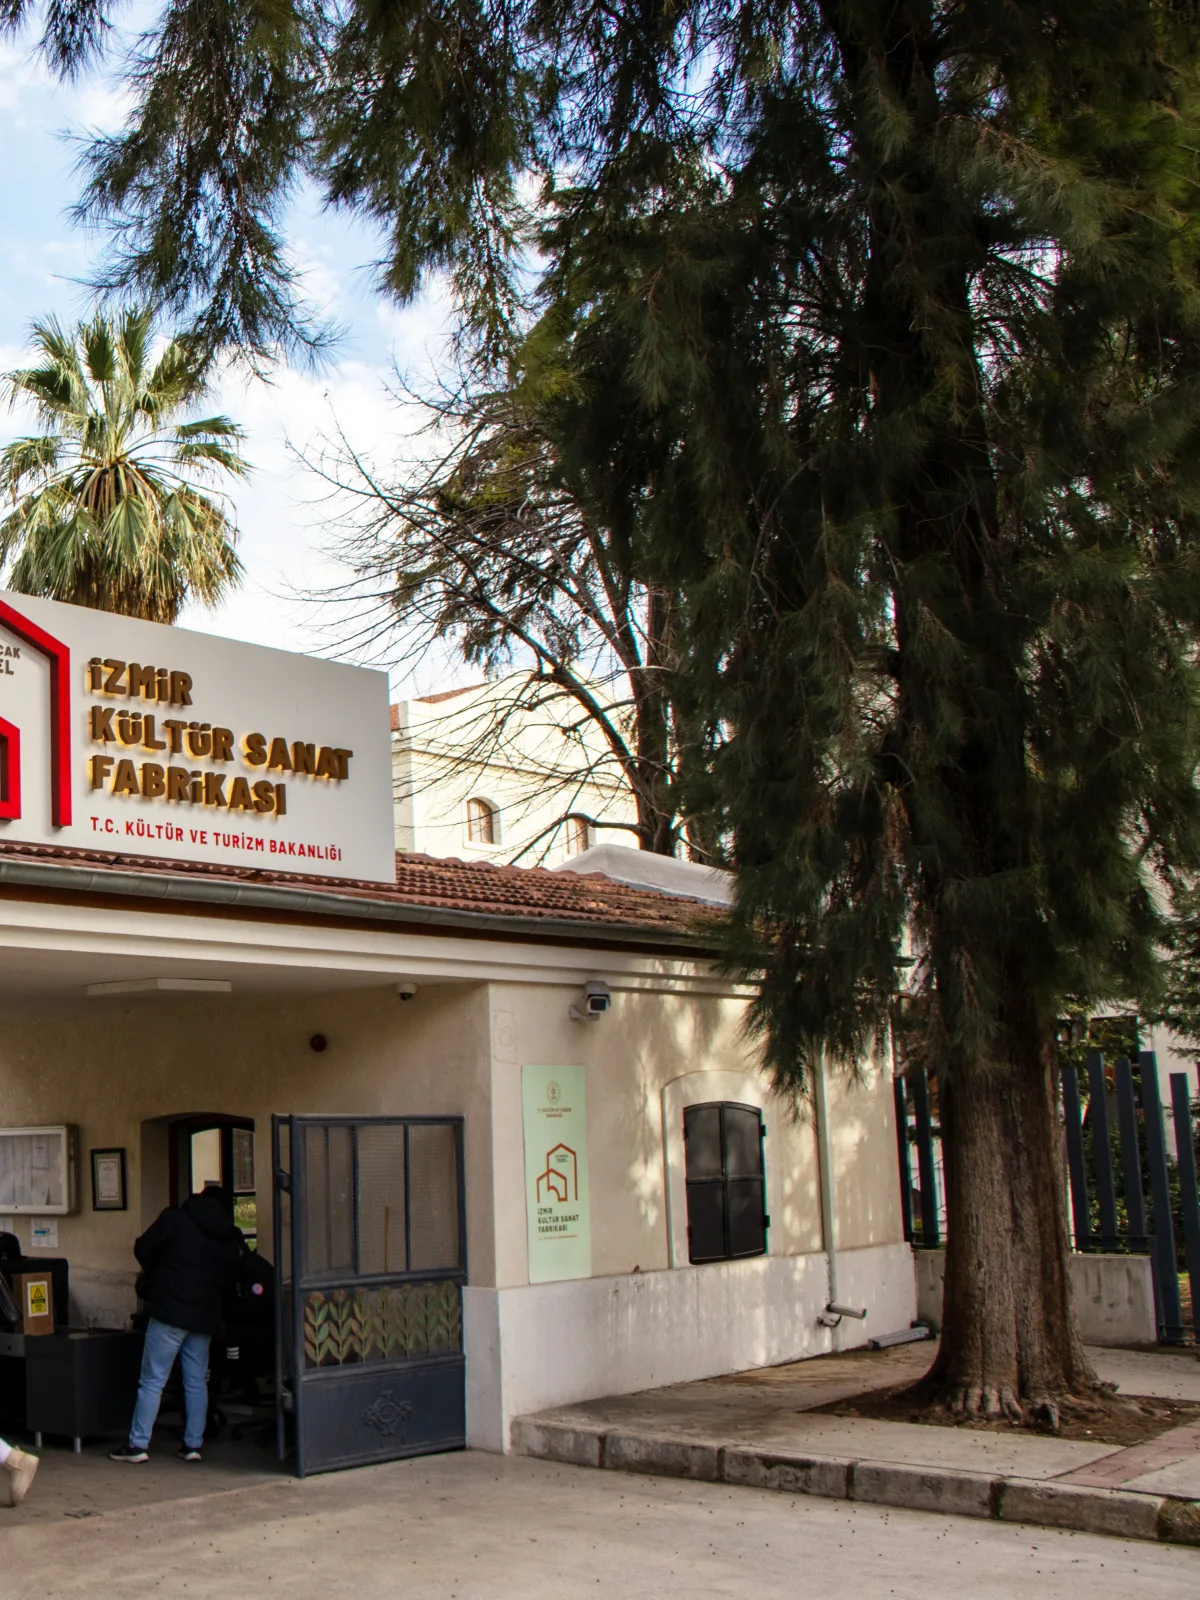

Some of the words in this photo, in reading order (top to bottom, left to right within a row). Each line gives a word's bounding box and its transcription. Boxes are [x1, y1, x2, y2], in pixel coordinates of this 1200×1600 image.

[89, 705, 235, 762] KÜLTÜR
[243, 732, 354, 780] SANAT
[89, 754, 287, 816] FABRİKASI
[90, 816, 120, 834] T.C.
[125, 818, 184, 842] KÜLTÜR
[190, 829, 208, 845] VE
[213, 831, 265, 852] TURİZM
[269, 838, 342, 862] BAKANLIĞI
[560, 1214, 579, 1223] SANAT
